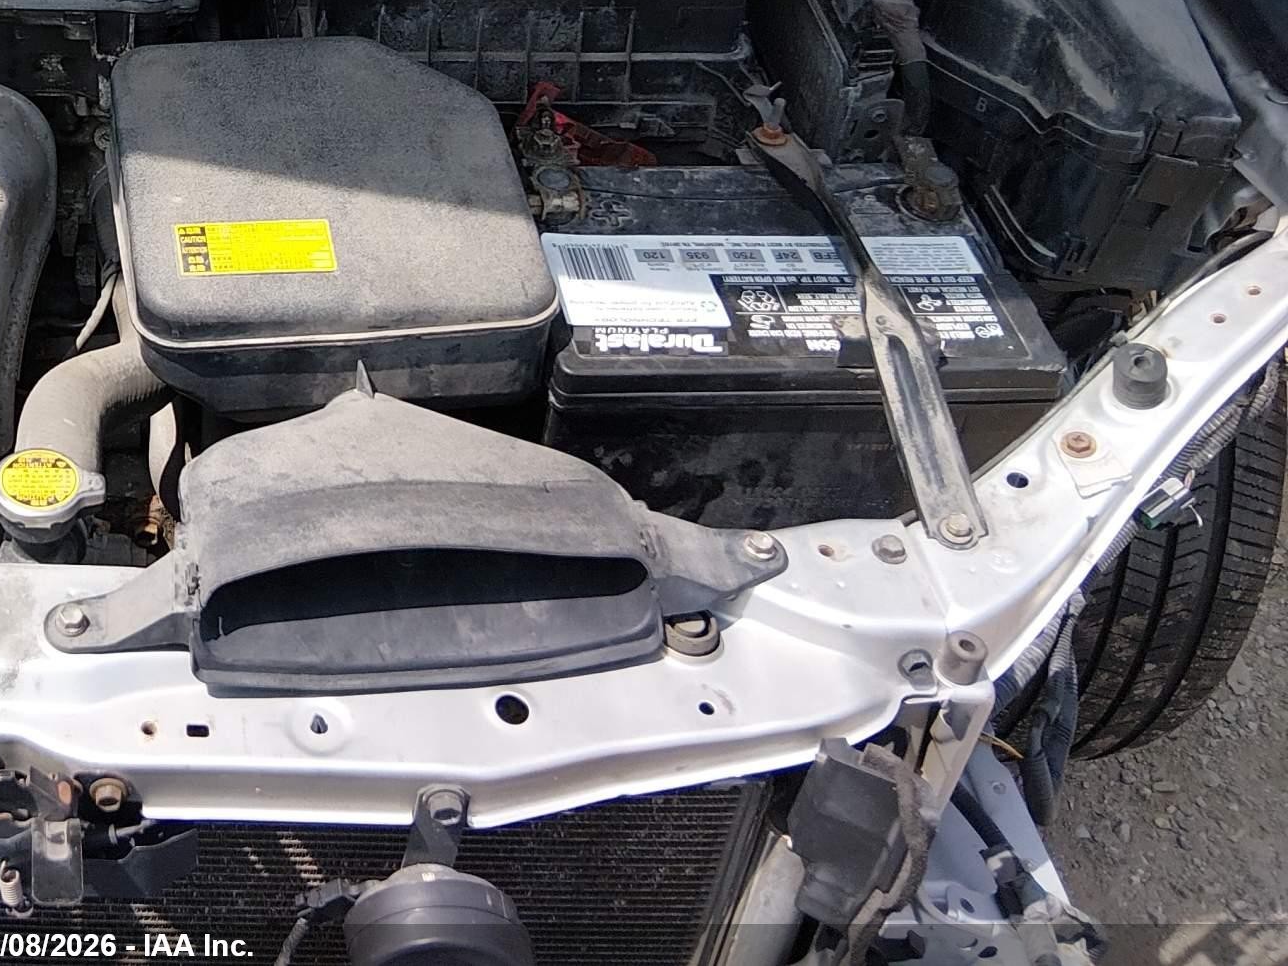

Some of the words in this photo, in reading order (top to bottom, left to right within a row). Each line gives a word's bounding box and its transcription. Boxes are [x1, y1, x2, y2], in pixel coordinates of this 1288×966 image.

[181, 235, 208, 244] CAUTION
[643, 250, 665, 260] 120
[686, 250, 710, 260] 935
[733, 251, 756, 260] 750
[775, 251, 798, 260] 24F
[595, 327, 669, 335] PLATINUM
[594, 334, 724, 353] Duralast
